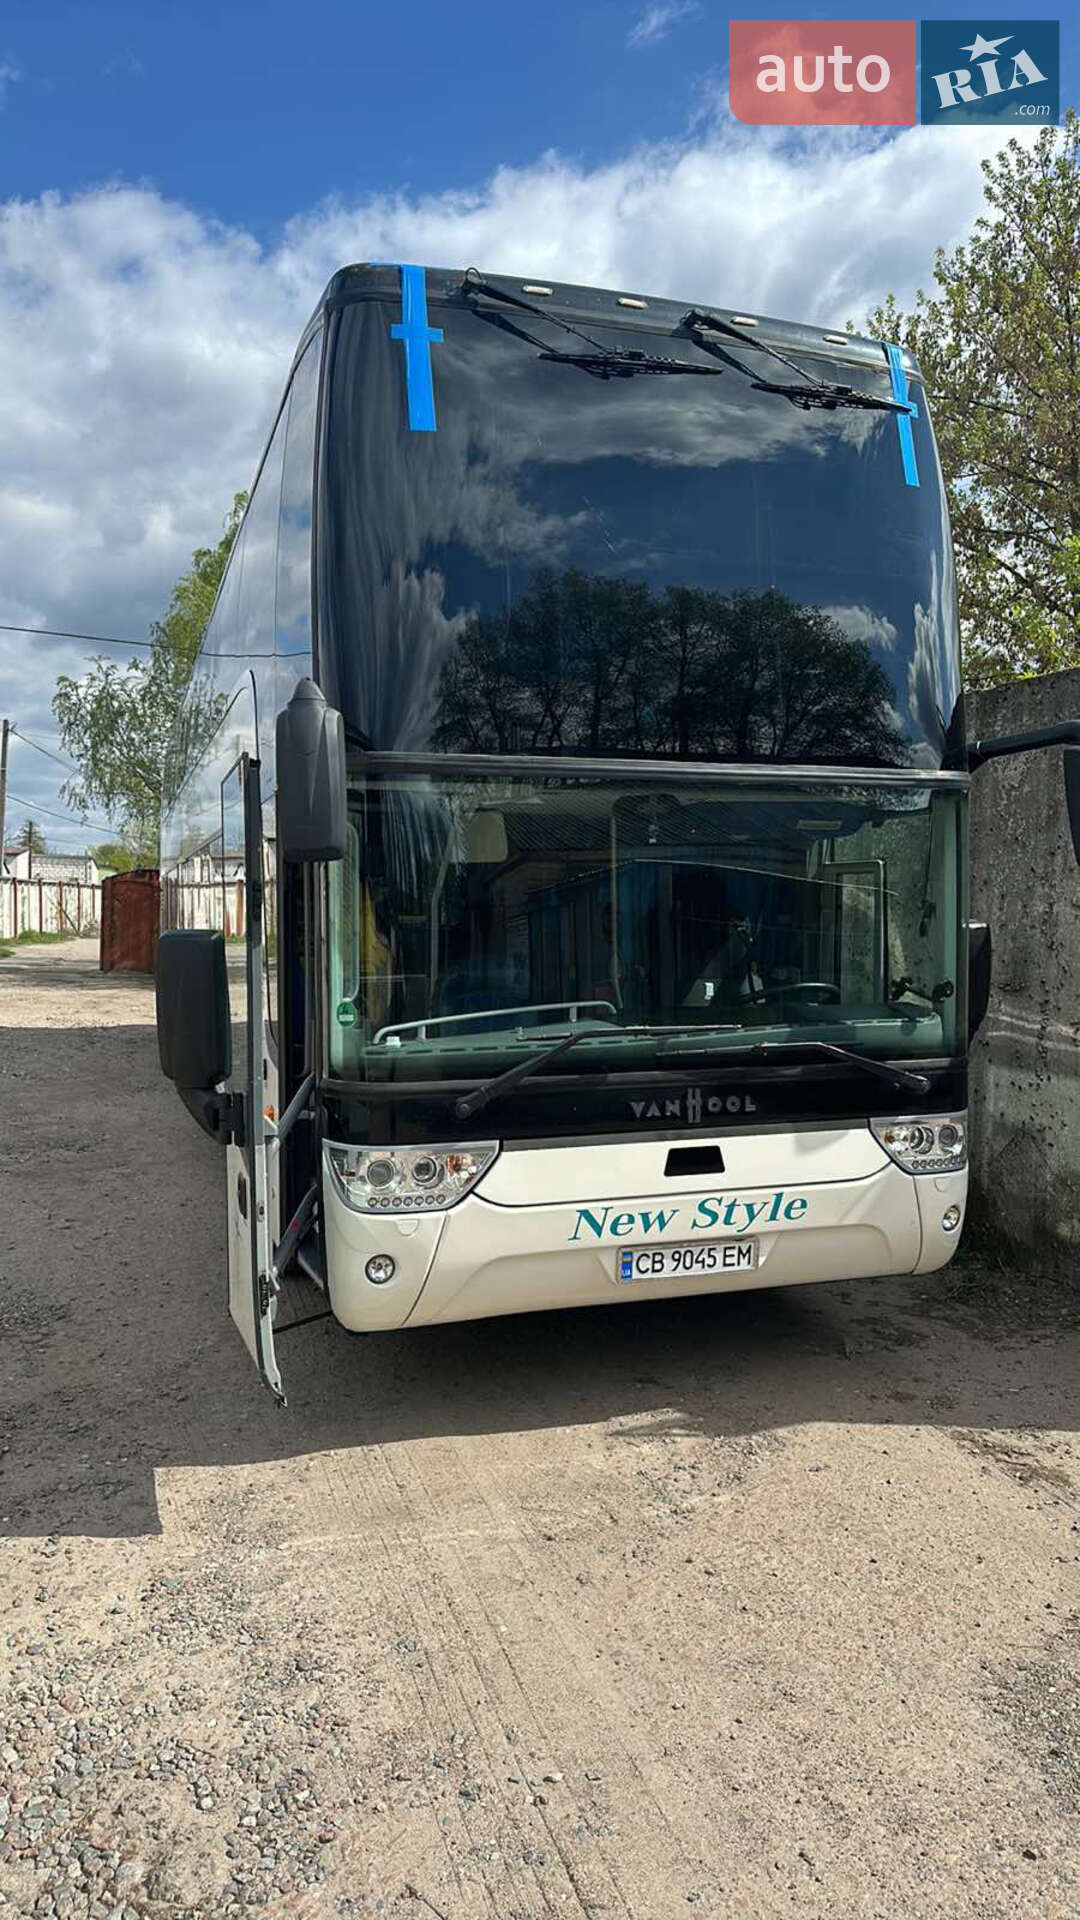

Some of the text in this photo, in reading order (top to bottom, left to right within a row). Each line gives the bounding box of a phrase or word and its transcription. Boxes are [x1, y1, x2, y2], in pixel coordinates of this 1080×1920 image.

[568, 1191, 808, 1241] New Style
[635, 1244, 752, 1274] CB 9045 EM
